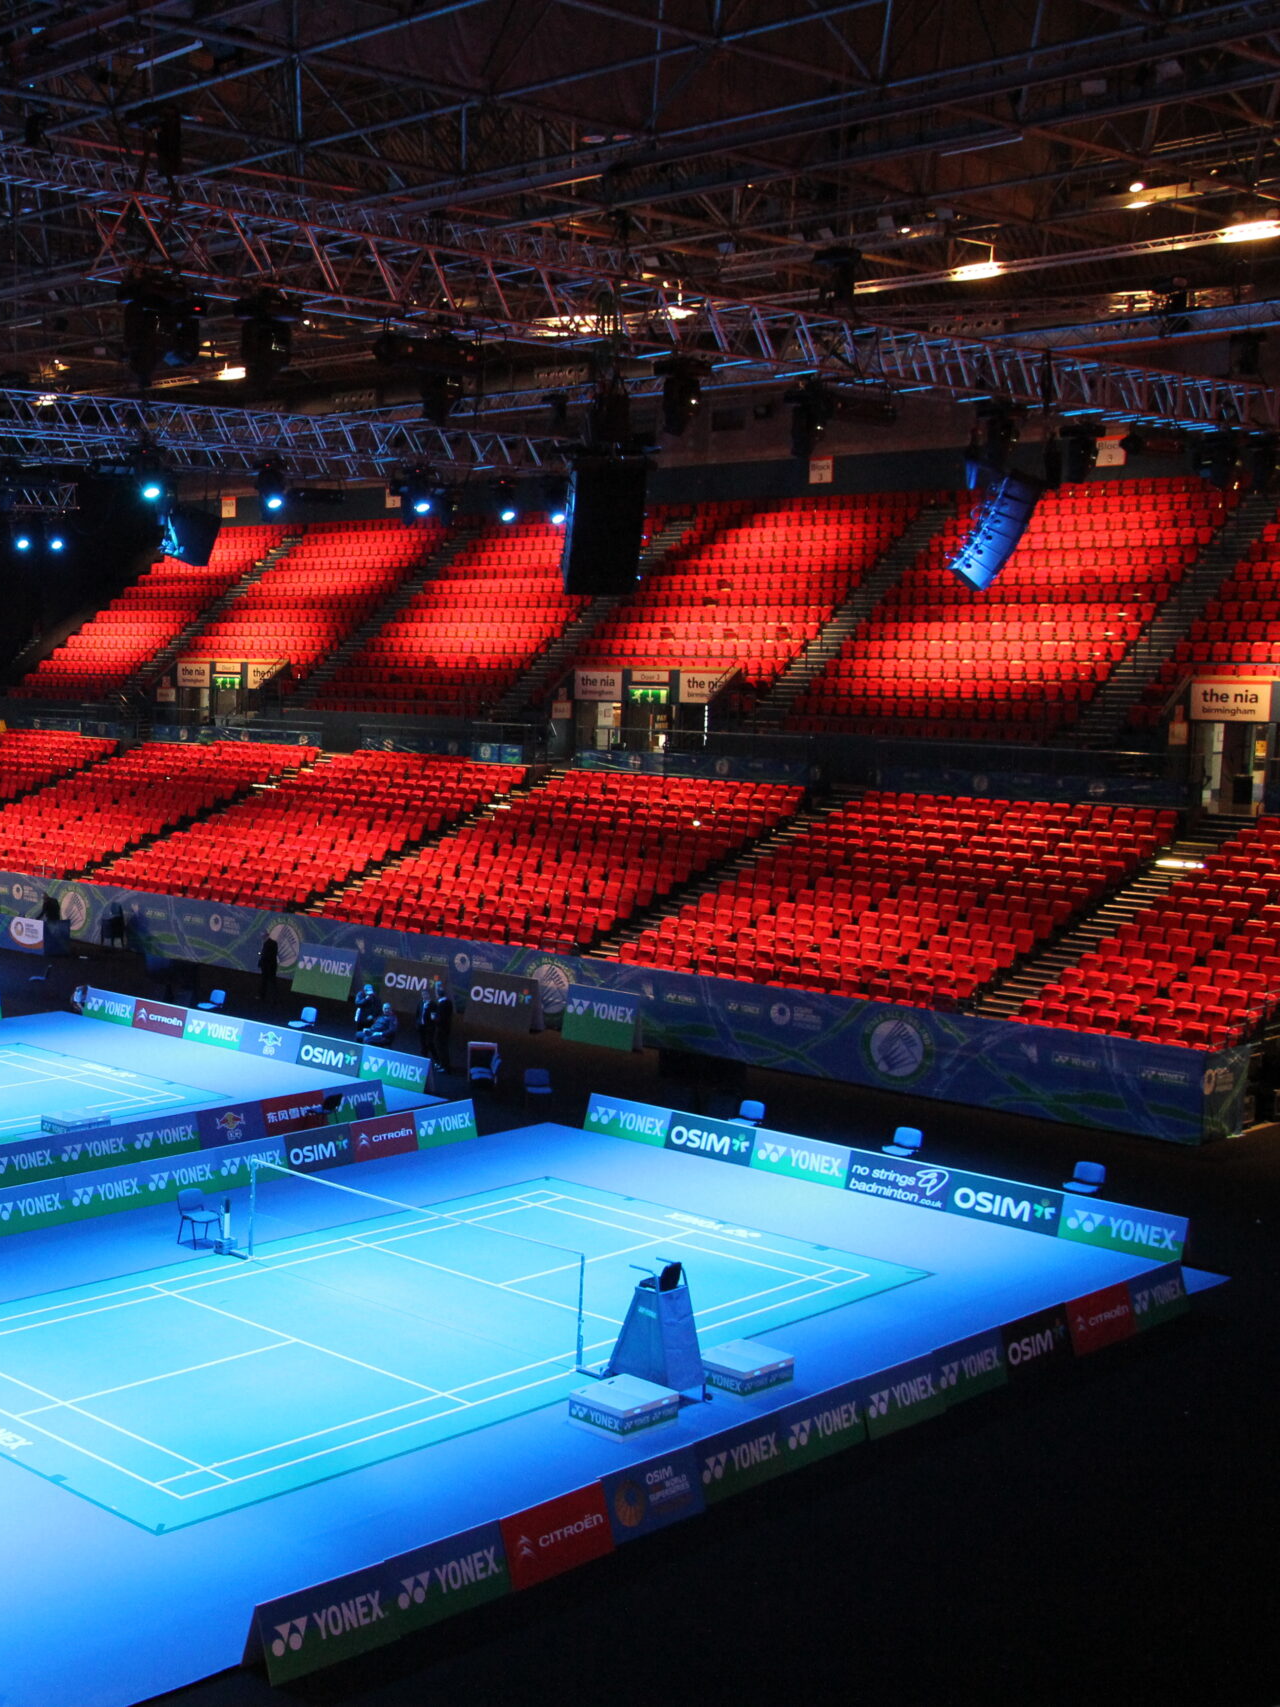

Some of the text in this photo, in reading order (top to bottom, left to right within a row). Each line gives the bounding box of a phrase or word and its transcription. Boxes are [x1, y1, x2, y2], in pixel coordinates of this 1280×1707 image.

[182, 666, 205, 676] the nia
[581, 676, 615, 686] the nia
[687, 678, 705, 689] the
[1202, 688, 1258, 704] the nia
[1202, 706, 1256, 716] birmingham
[319, 957, 353, 978] YONEX
[384, 972, 428, 992] OSIM
[470, 985, 518, 1007] OSIM
[104, 1002, 133, 1019] YONEX
[148, 1012, 184, 1028] CITROËN
[592, 1000, 634, 1024] YONEX
[207, 1022, 241, 1043] YONEX
[300, 1044, 344, 1068] OSIM
[386, 1060, 424, 1082] YONEX
[438, 1112, 472, 1132] YONEX
[619, 1110, 665, 1137] YONEX
[156, 1124, 195, 1145] YONEX
[372, 1128, 413, 1144] CITROËN
[670, 1125, 730, 1155] OSIM
[84, 1136, 127, 1158] YONEX
[289, 1144, 337, 1166] OSIM
[10, 1149, 54, 1171] YONEX
[790, 1148, 842, 1178] YONEX
[172, 1164, 214, 1187] YONEX
[852, 1164, 916, 1186] no strings
[96, 1178, 140, 1200] YONEX
[16, 1192, 64, 1217] YONEX
[954, 1186, 1031, 1222] OSIM
[1110, 1216, 1178, 1252] YONEX
[1150, 1278, 1184, 1307] YONEX
[1088, 1304, 1130, 1328] CITROËN
[1008, 1328, 1054, 1366] OSIM
[960, 1345, 1001, 1380] YONEX
[711, 1374, 742, 1392] YONEX
[891, 1372, 936, 1409] YONEX
[590, 1409, 620, 1432] YONEX
[815, 1400, 861, 1439] YONEX
[730, 1432, 781, 1471] YONEX
[645, 1465, 674, 1486] OSIM
[664, 1474, 687, 1489] WORLD
[538, 1512, 604, 1549] CITROËN
[434, 1545, 502, 1595] YONEX
[313, 1590, 390, 1640] YONEX
